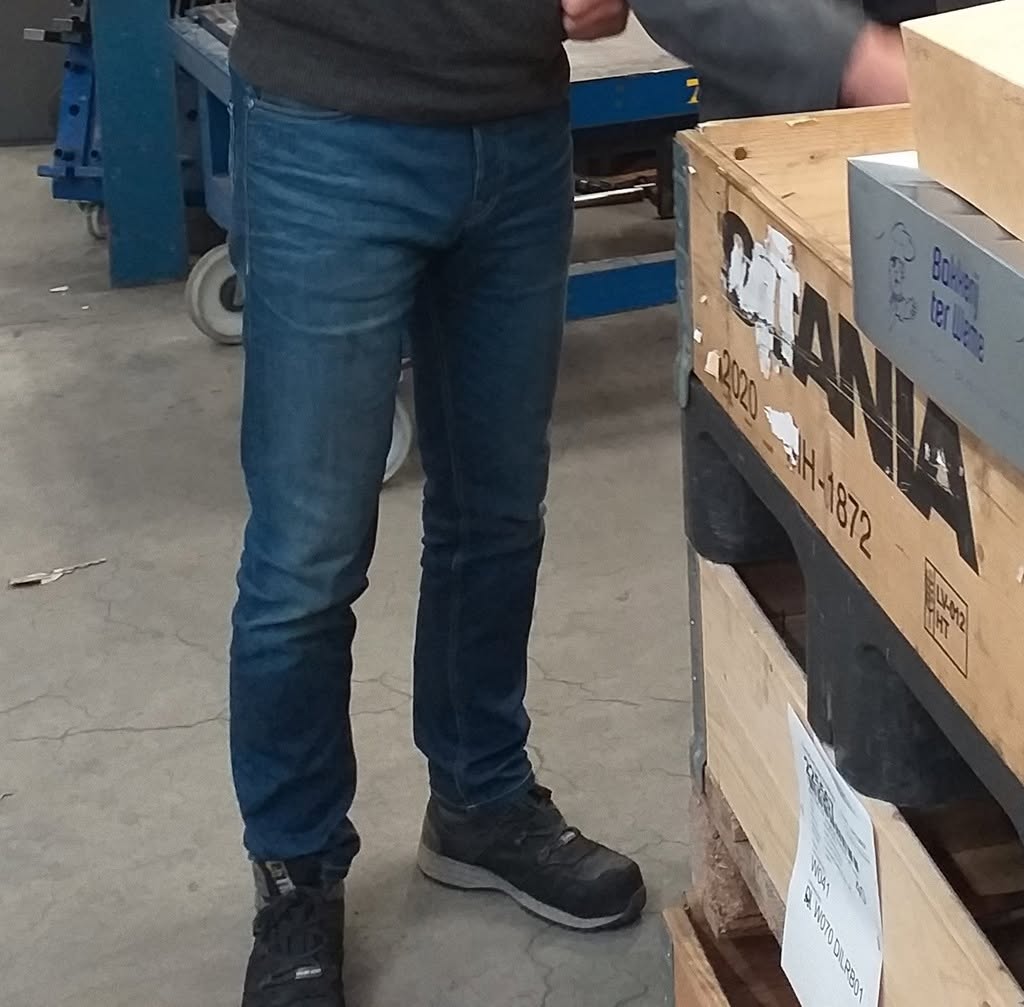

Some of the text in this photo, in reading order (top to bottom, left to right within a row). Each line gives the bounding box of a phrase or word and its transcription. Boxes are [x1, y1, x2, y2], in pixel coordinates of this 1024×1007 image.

[930, 290, 950, 330] ter
[721, 210, 980, 576] SANIA
[811, 854, 830, 898] W041
[813, 899, 834, 945] W070
